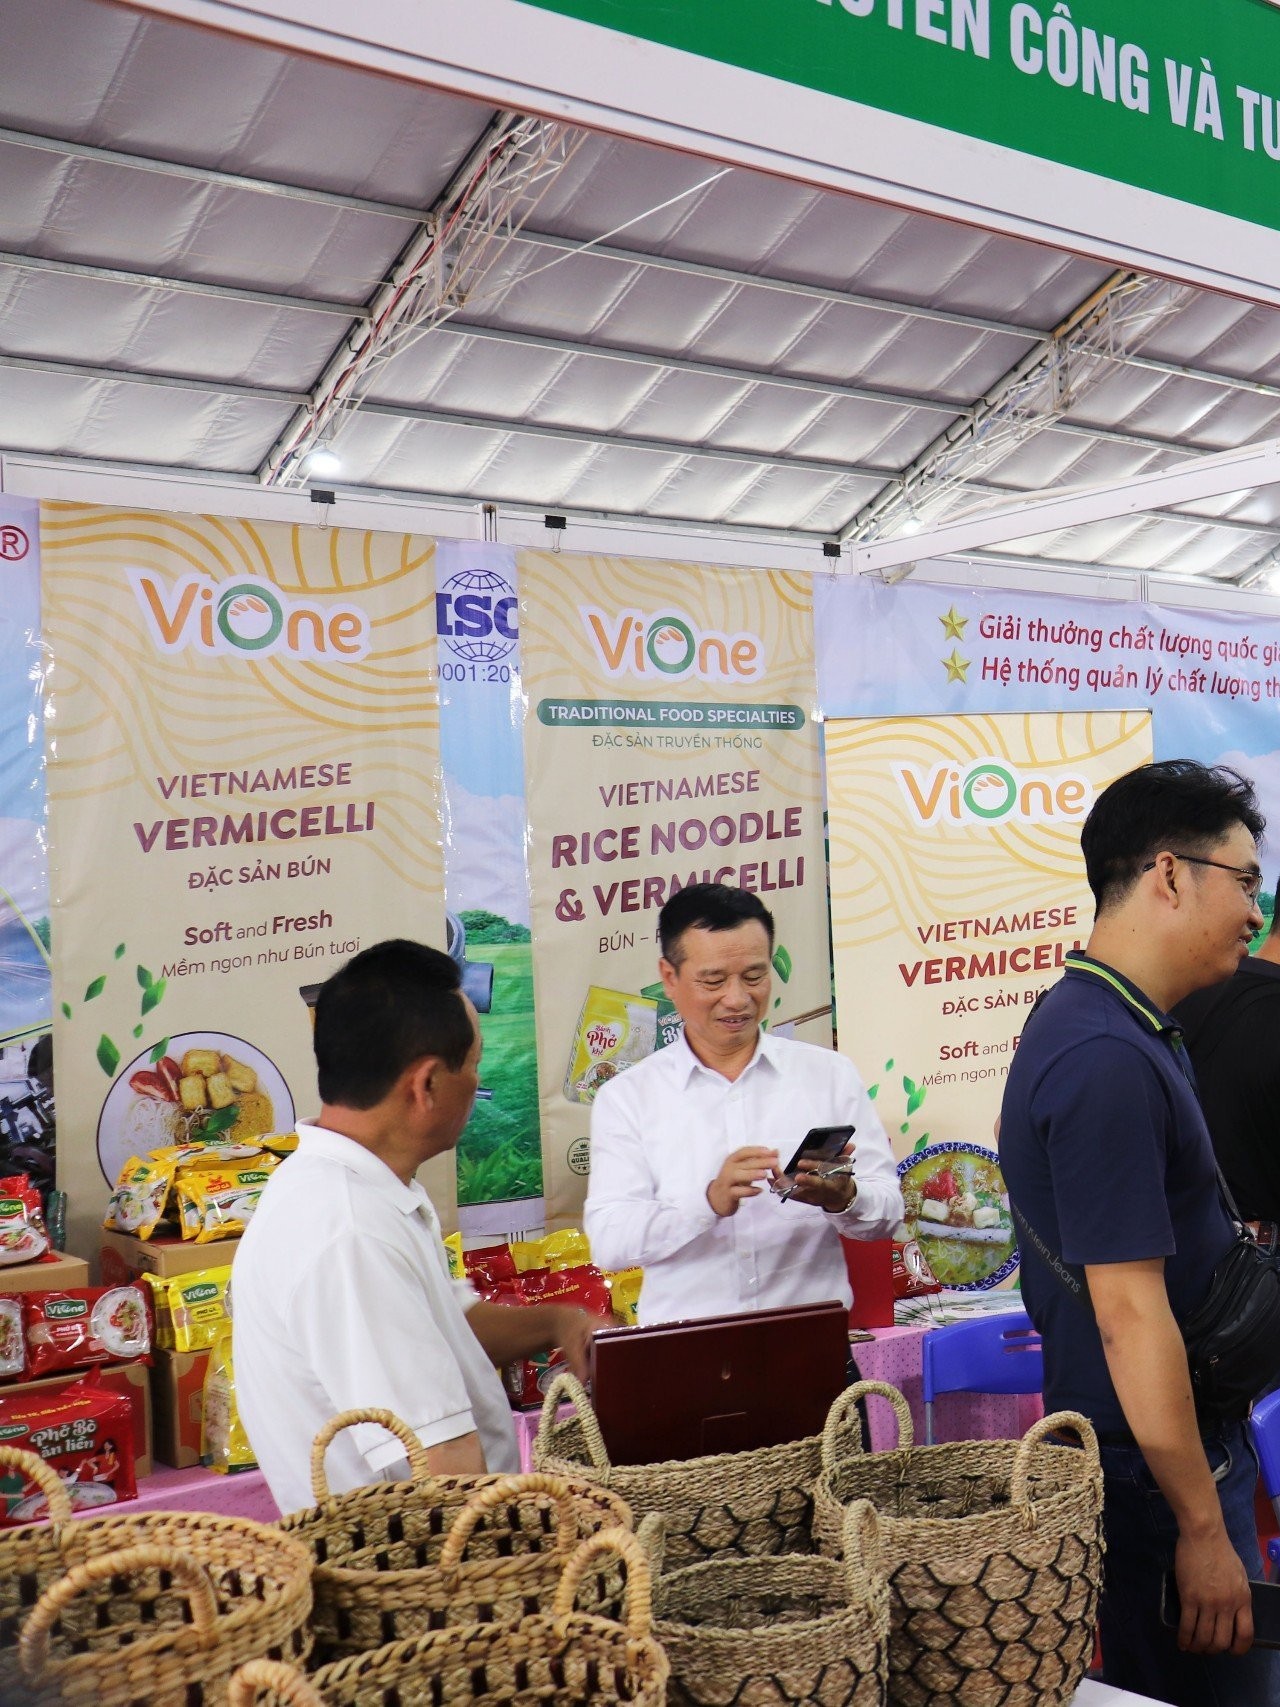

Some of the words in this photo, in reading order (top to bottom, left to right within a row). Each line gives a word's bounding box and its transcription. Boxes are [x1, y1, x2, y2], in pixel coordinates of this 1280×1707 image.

[1009, 3, 1150, 114] CÔNG
[1163, 58, 1224, 141] VÀ
[139, 577, 363, 655] ViOne
[587, 613, 758, 676] ViOne
[979, 614, 1022, 640] Giải
[1027, 617, 1103, 652] thưởng
[1109, 624, 1155, 651] chất
[1159, 628, 1212, 661] lượng
[1217, 635, 1258, 662] quốc
[981, 656, 1012, 687] Hệ
[1017, 656, 1080, 691] thống
[1086, 663, 1138, 692] quản
[1145, 665, 1164, 696] lý
[1167, 667, 1207, 694] chất
[1210, 670, 1261, 702] lượng
[548, 705, 657, 722] TRADITIONAL
[659, 707, 704, 723] FOOD
[707, 709, 796, 725] SPECIALTIES
[591, 733, 623, 751] ĐẶC
[626, 732, 653, 748] SẢN
[656, 733, 711, 749] TRUYỀN
[713, 734, 763, 749] THỐNG
[156, 762, 353, 801] VIETNAMESE
[598, 769, 761, 808] VIETNAMESE
[901, 764, 1086, 820] ViOne
[133, 801, 376, 854] VERMICELLI
[551, 825, 641, 869] RICE
[650, 806, 803, 858] NOODLE
[187, 866, 234, 892] ĐẶC
[238, 857, 280, 884] SẢN
[287, 854, 332, 880] BÚN
[555, 887, 587, 923] &
[183, 922, 233, 946] Soft
[236, 921, 268, 940] and
[272, 909, 333, 934] Fresh
[598, 930, 634, 954] BÚN
[917, 906, 1078, 945] VIETNAMESE
[161, 958, 206, 978] Mềm
[210, 955, 252, 973] ngon
[257, 948, 289, 965] như
[293, 943, 325, 960] Bún
[329, 936, 361, 955] tươi
[942, 996, 980, 1018] ĐẶC
[983, 988, 1019, 1010] SẢN
[586, 1030, 618, 1050] Phở
[939, 1041, 980, 1061] Soft
[982, 1040, 1009, 1055] and
[921, 1069, 958, 1087] Mềm
[960, 1066, 997, 1083] ngon
[1048, 1256, 1081, 1293] Jeans
[29, 1424, 70, 1447] Phở
[72, 1419, 97, 1436] Bò
[41, 1445, 62, 1458] ăn
[65, 1435, 94, 1452] liền
